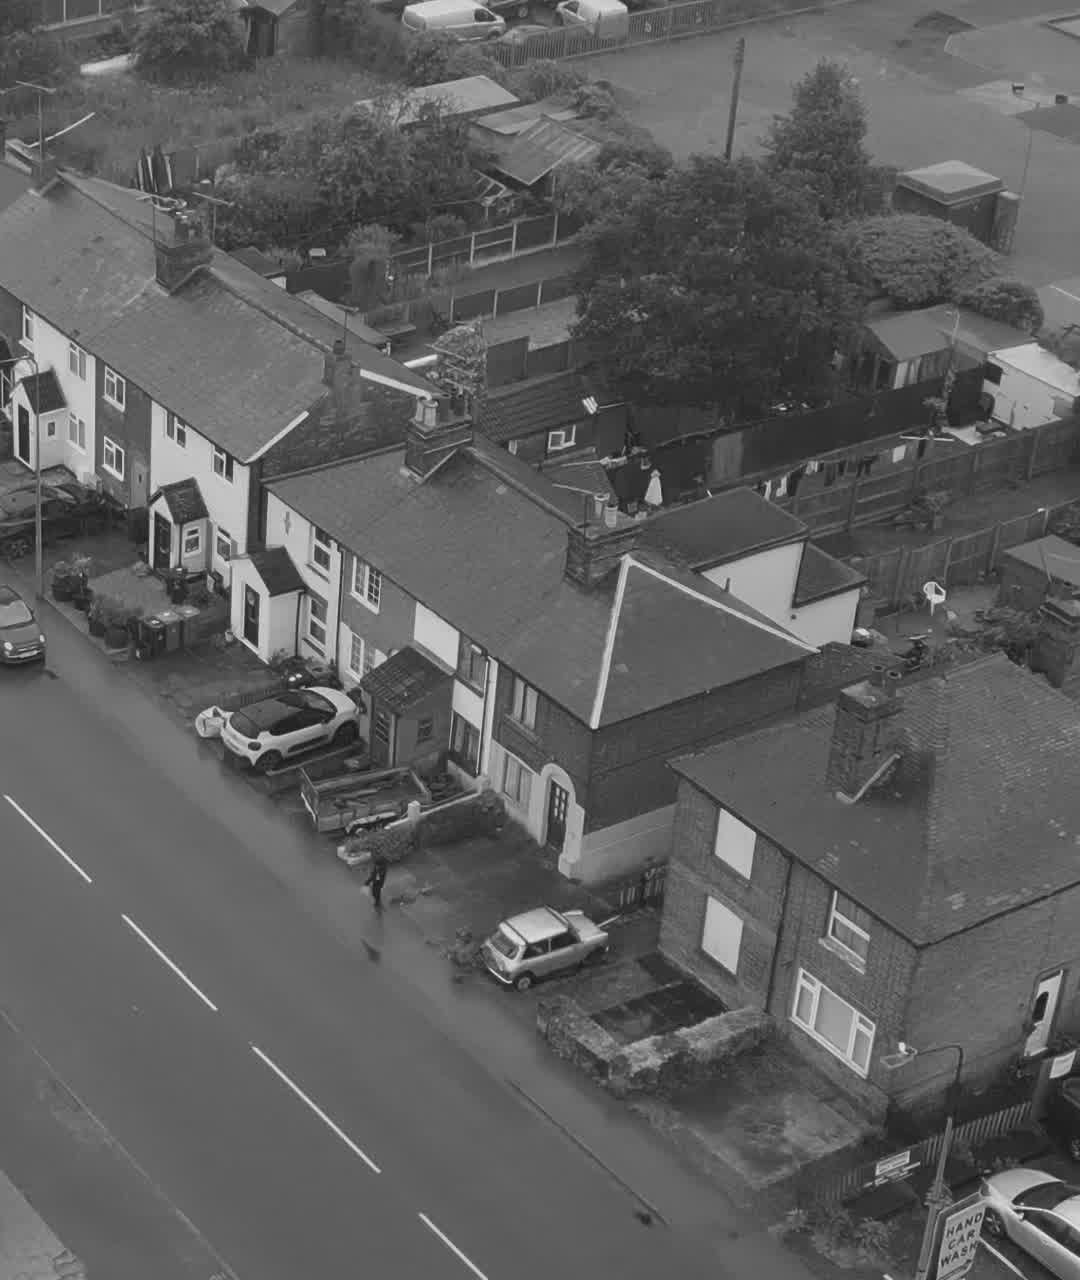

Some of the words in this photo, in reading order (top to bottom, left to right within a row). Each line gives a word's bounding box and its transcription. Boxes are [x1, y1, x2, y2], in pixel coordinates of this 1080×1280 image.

[946, 1212, 982, 1238] HAND
[948, 1228, 976, 1250] CAR
[940, 1240, 978, 1268] WASH
